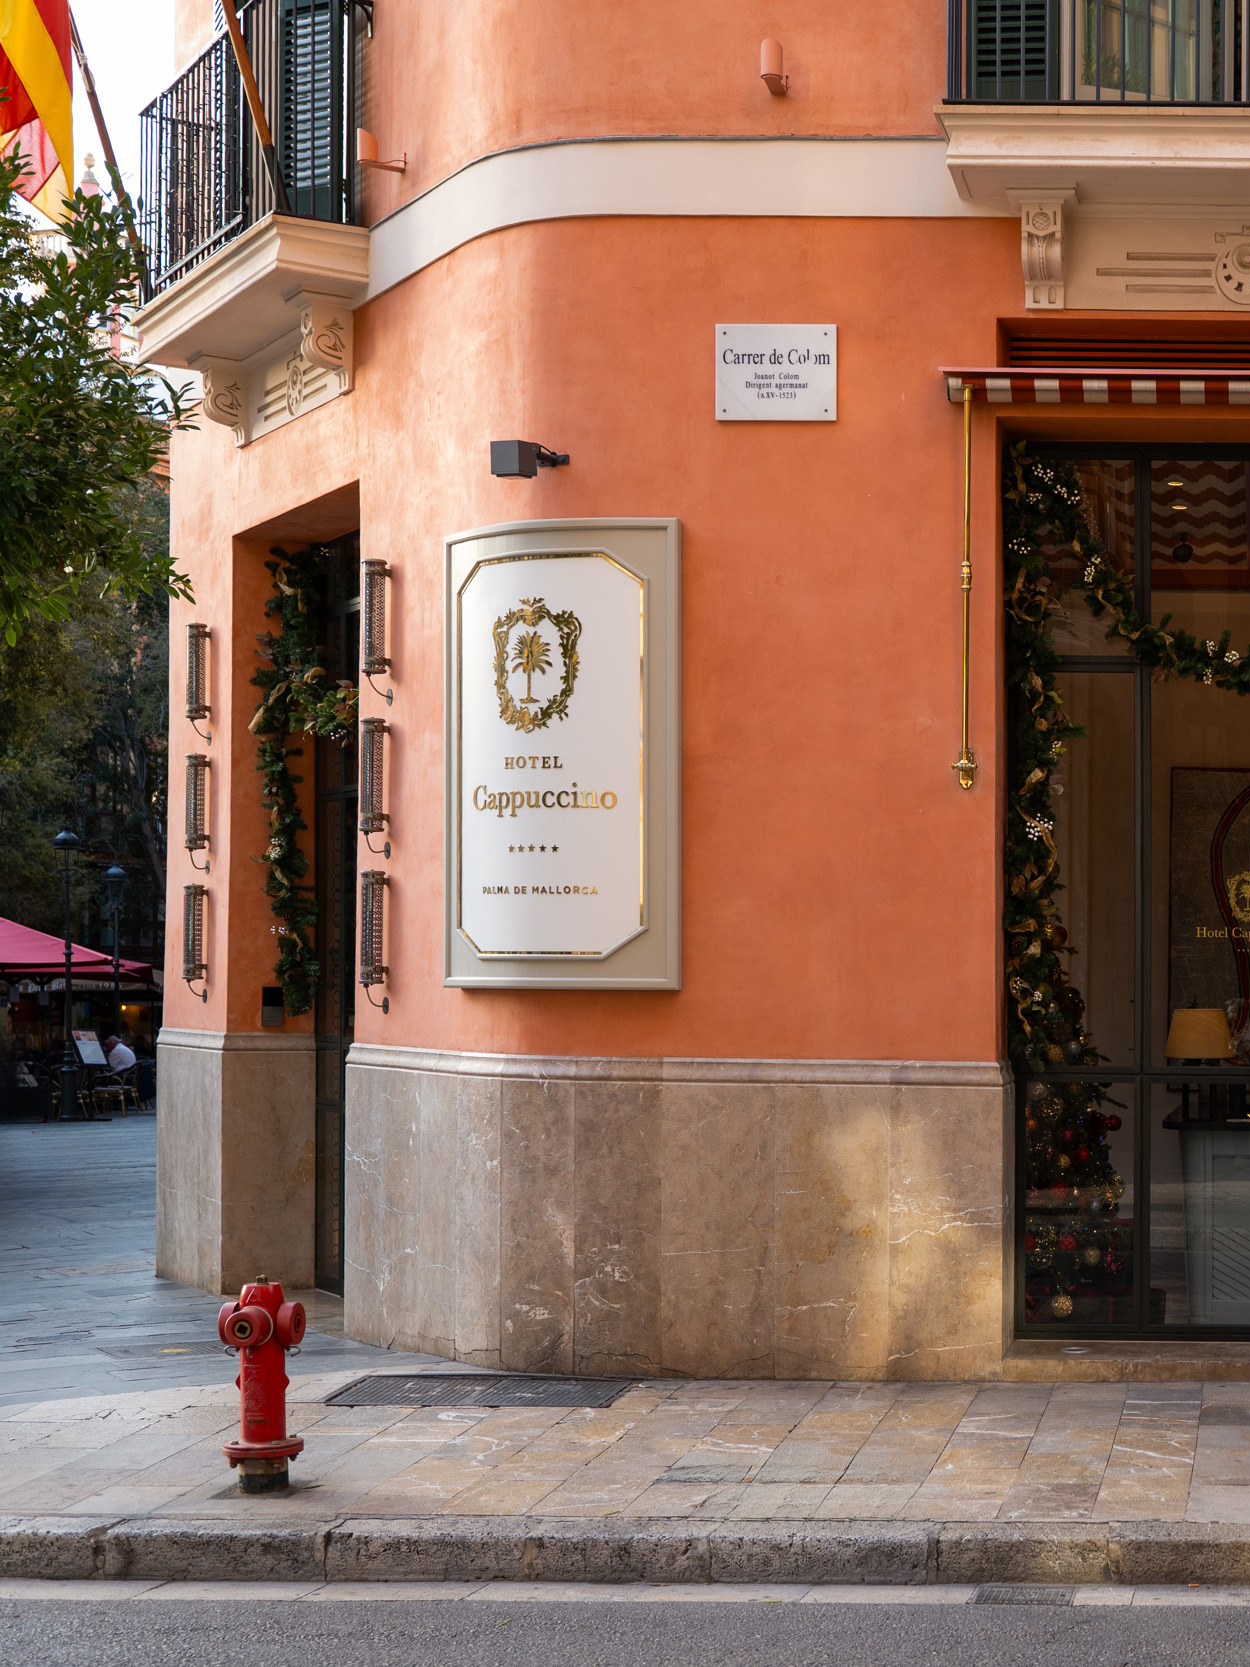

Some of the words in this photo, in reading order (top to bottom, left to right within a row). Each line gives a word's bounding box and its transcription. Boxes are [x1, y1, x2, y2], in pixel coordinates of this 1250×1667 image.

[722, 348, 766, 365] Carrer
[769, 348, 784, 365] de
[754, 372, 775, 380] Joanot
[778, 372, 799, 380] Colom
[745, 381, 772, 390] Dirigent
[775, 382, 808, 390] agermanat
[503, 755, 563, 770] HOTEL
[472, 782, 618, 818] Cappuccino
[482, 885, 510, 895] PALMA
[513, 885, 527, 895] DE
[531, 885, 599, 895] MALLORCA
[1195, 926, 1228, 938] Hotel
